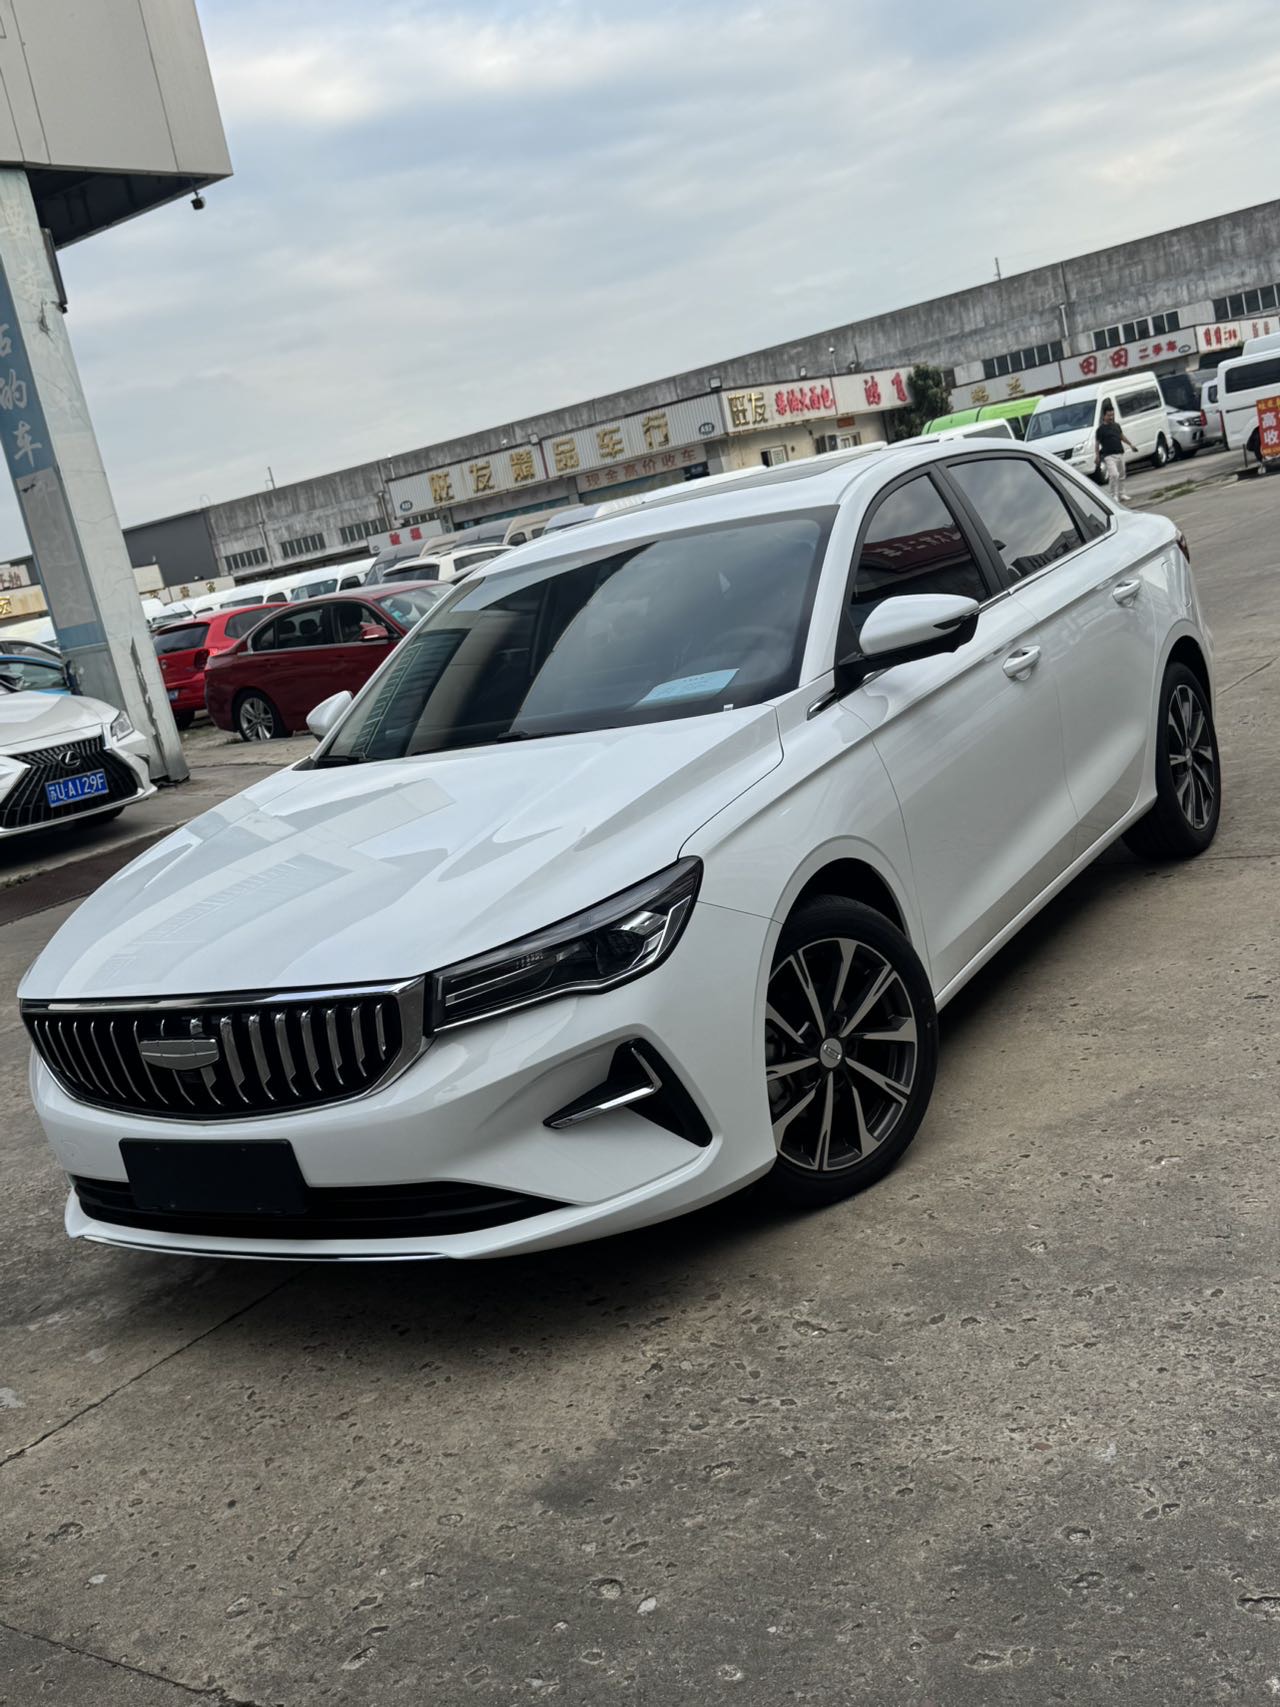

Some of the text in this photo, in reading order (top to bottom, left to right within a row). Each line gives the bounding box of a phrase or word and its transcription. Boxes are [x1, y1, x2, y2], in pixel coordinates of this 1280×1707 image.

[728, 391, 768, 428] 旺友
[585, 448, 697, 488] 现金高价收车
